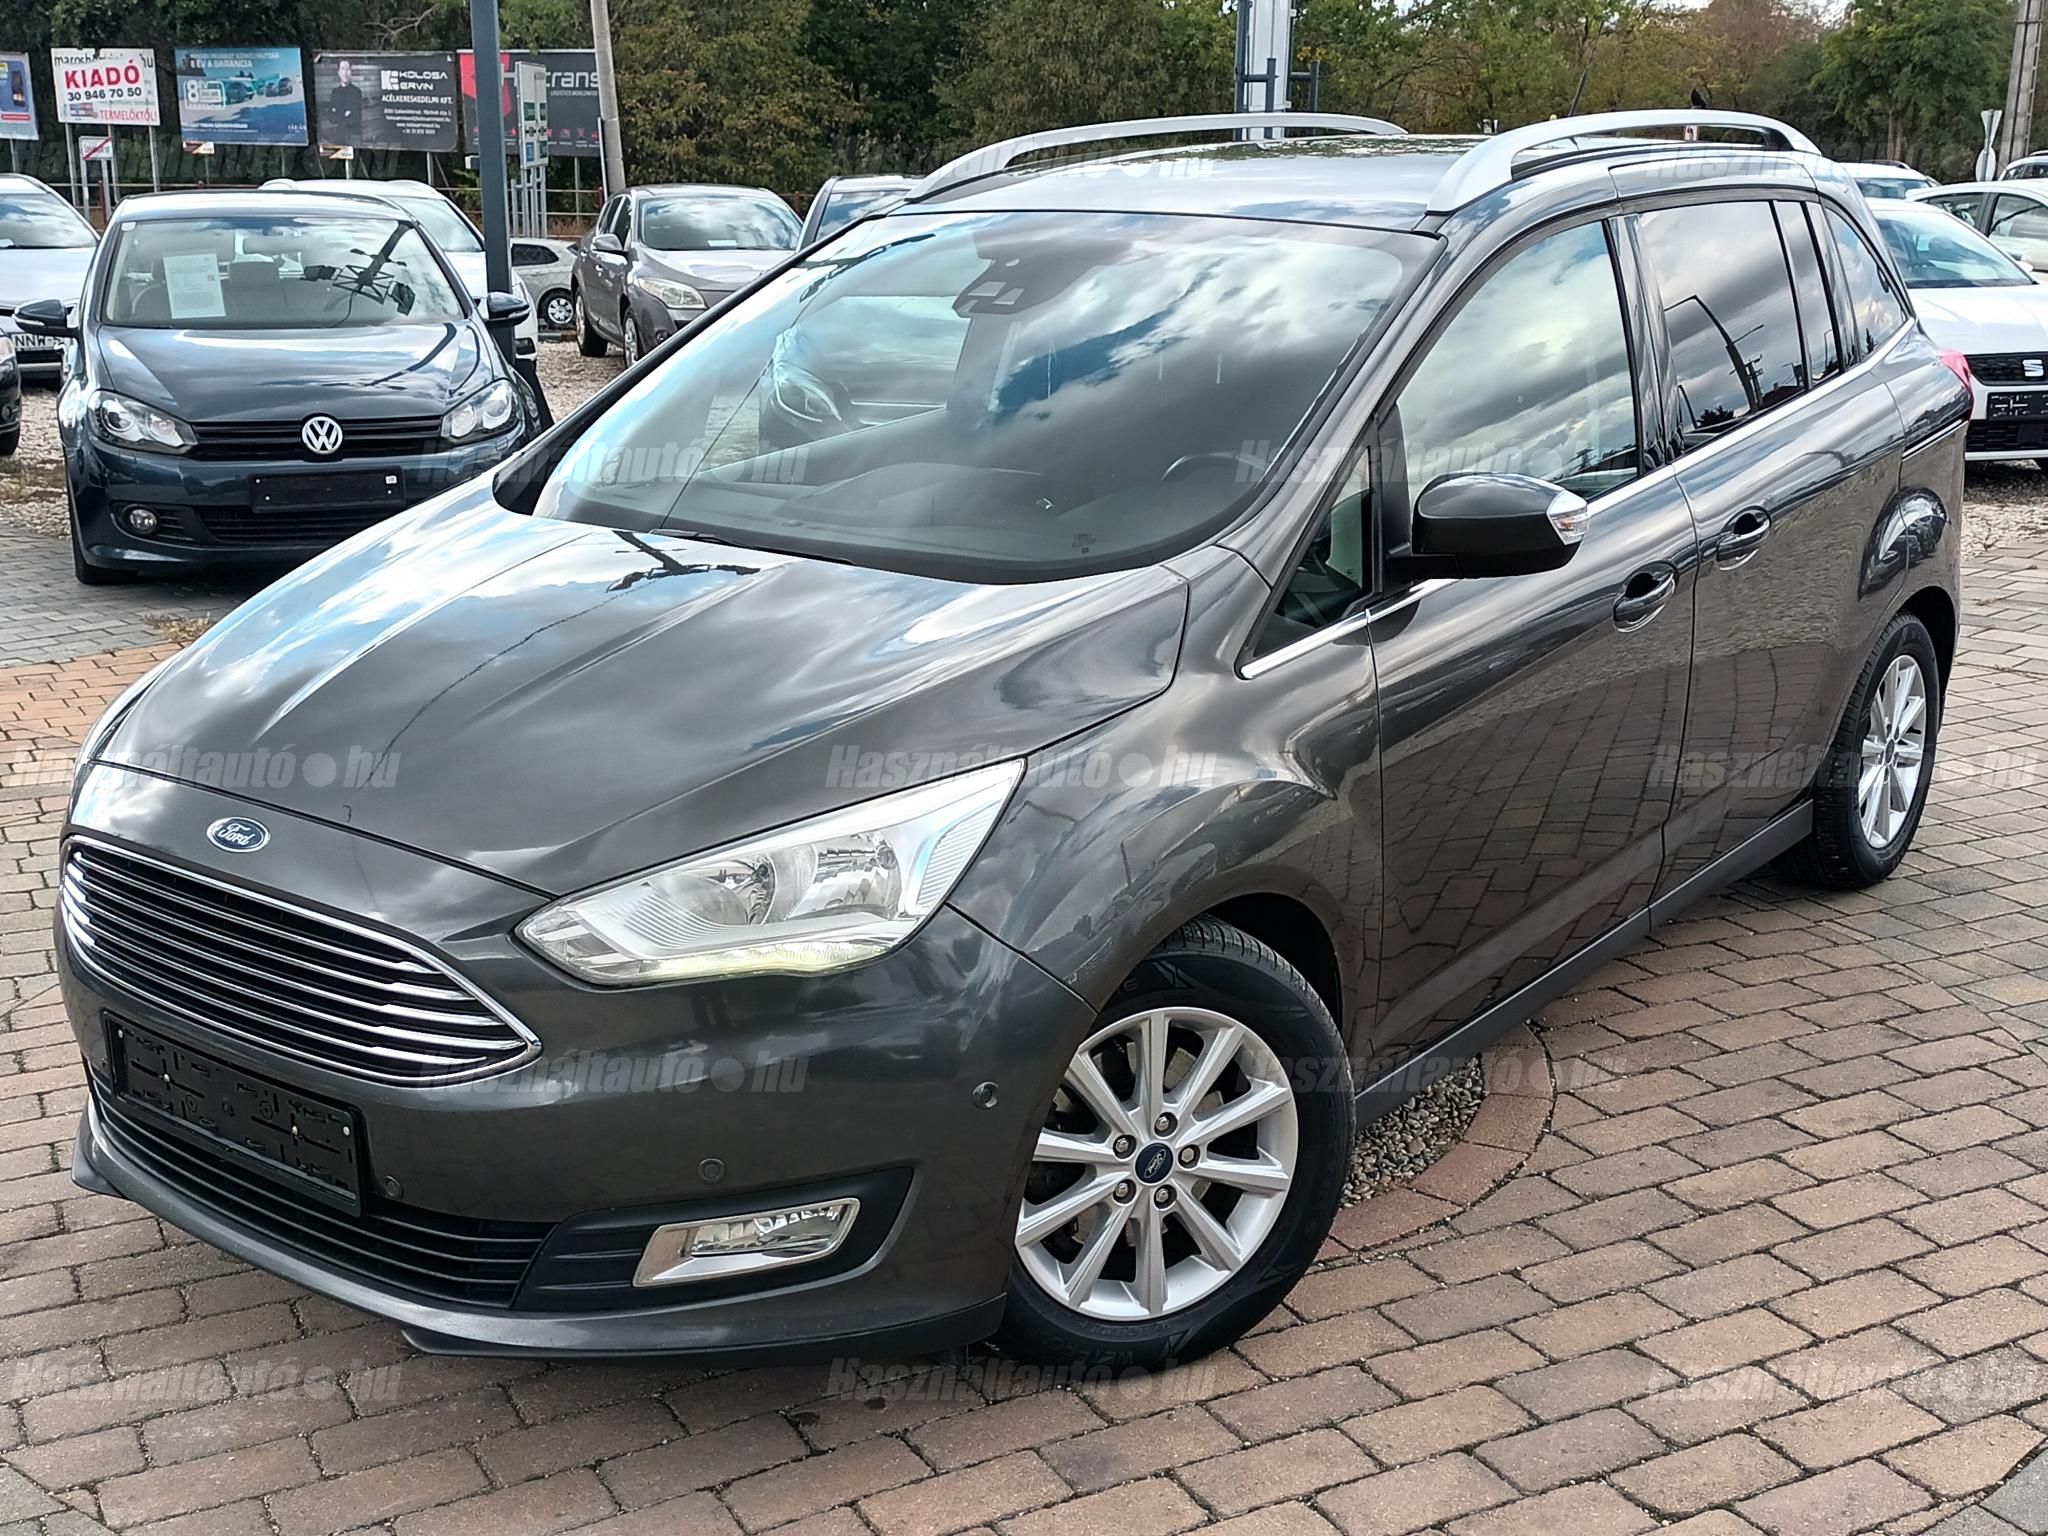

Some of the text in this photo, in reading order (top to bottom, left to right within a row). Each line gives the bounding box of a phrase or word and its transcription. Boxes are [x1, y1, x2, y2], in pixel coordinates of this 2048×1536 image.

[64, 59, 140, 89] KIADÓ
[67, 87, 142, 102] 30 946 70 50
[217, 822, 256, 846] Ford
